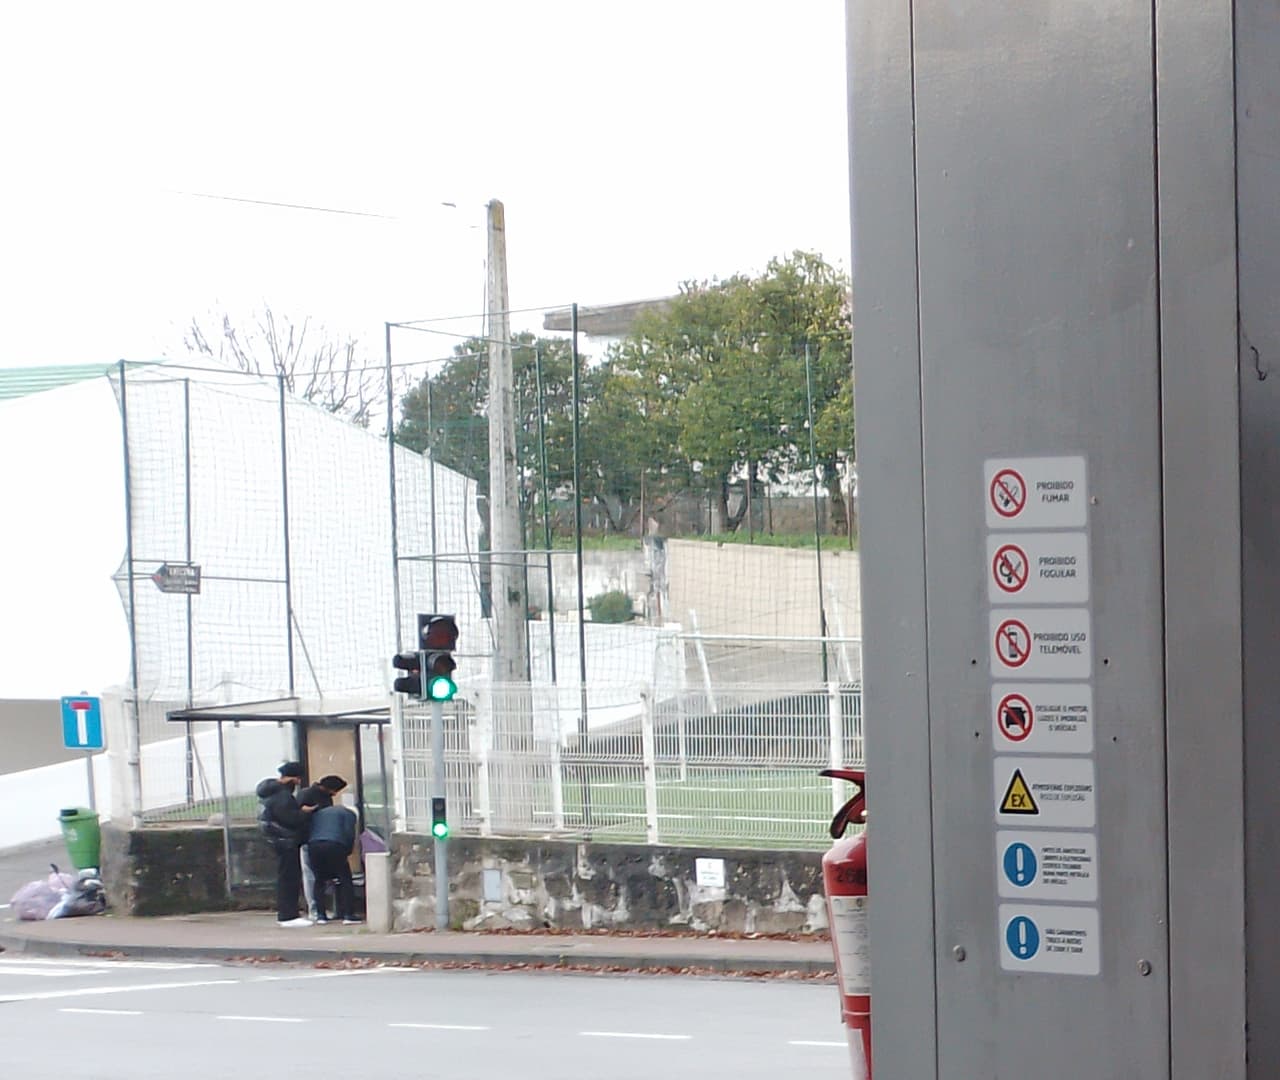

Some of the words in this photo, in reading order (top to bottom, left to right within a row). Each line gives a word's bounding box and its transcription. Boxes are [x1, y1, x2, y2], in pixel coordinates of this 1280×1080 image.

[1036, 480, 1074, 490] PROIBIDO
[1041, 493, 1069, 503] FUMAR
[1038, 556, 1076, 566] PROIBIDO
[1033, 632, 1068, 641] PROIBIDO
[1070, 632, 1086, 641] USO
[1011, 794, 1026, 808] EX
